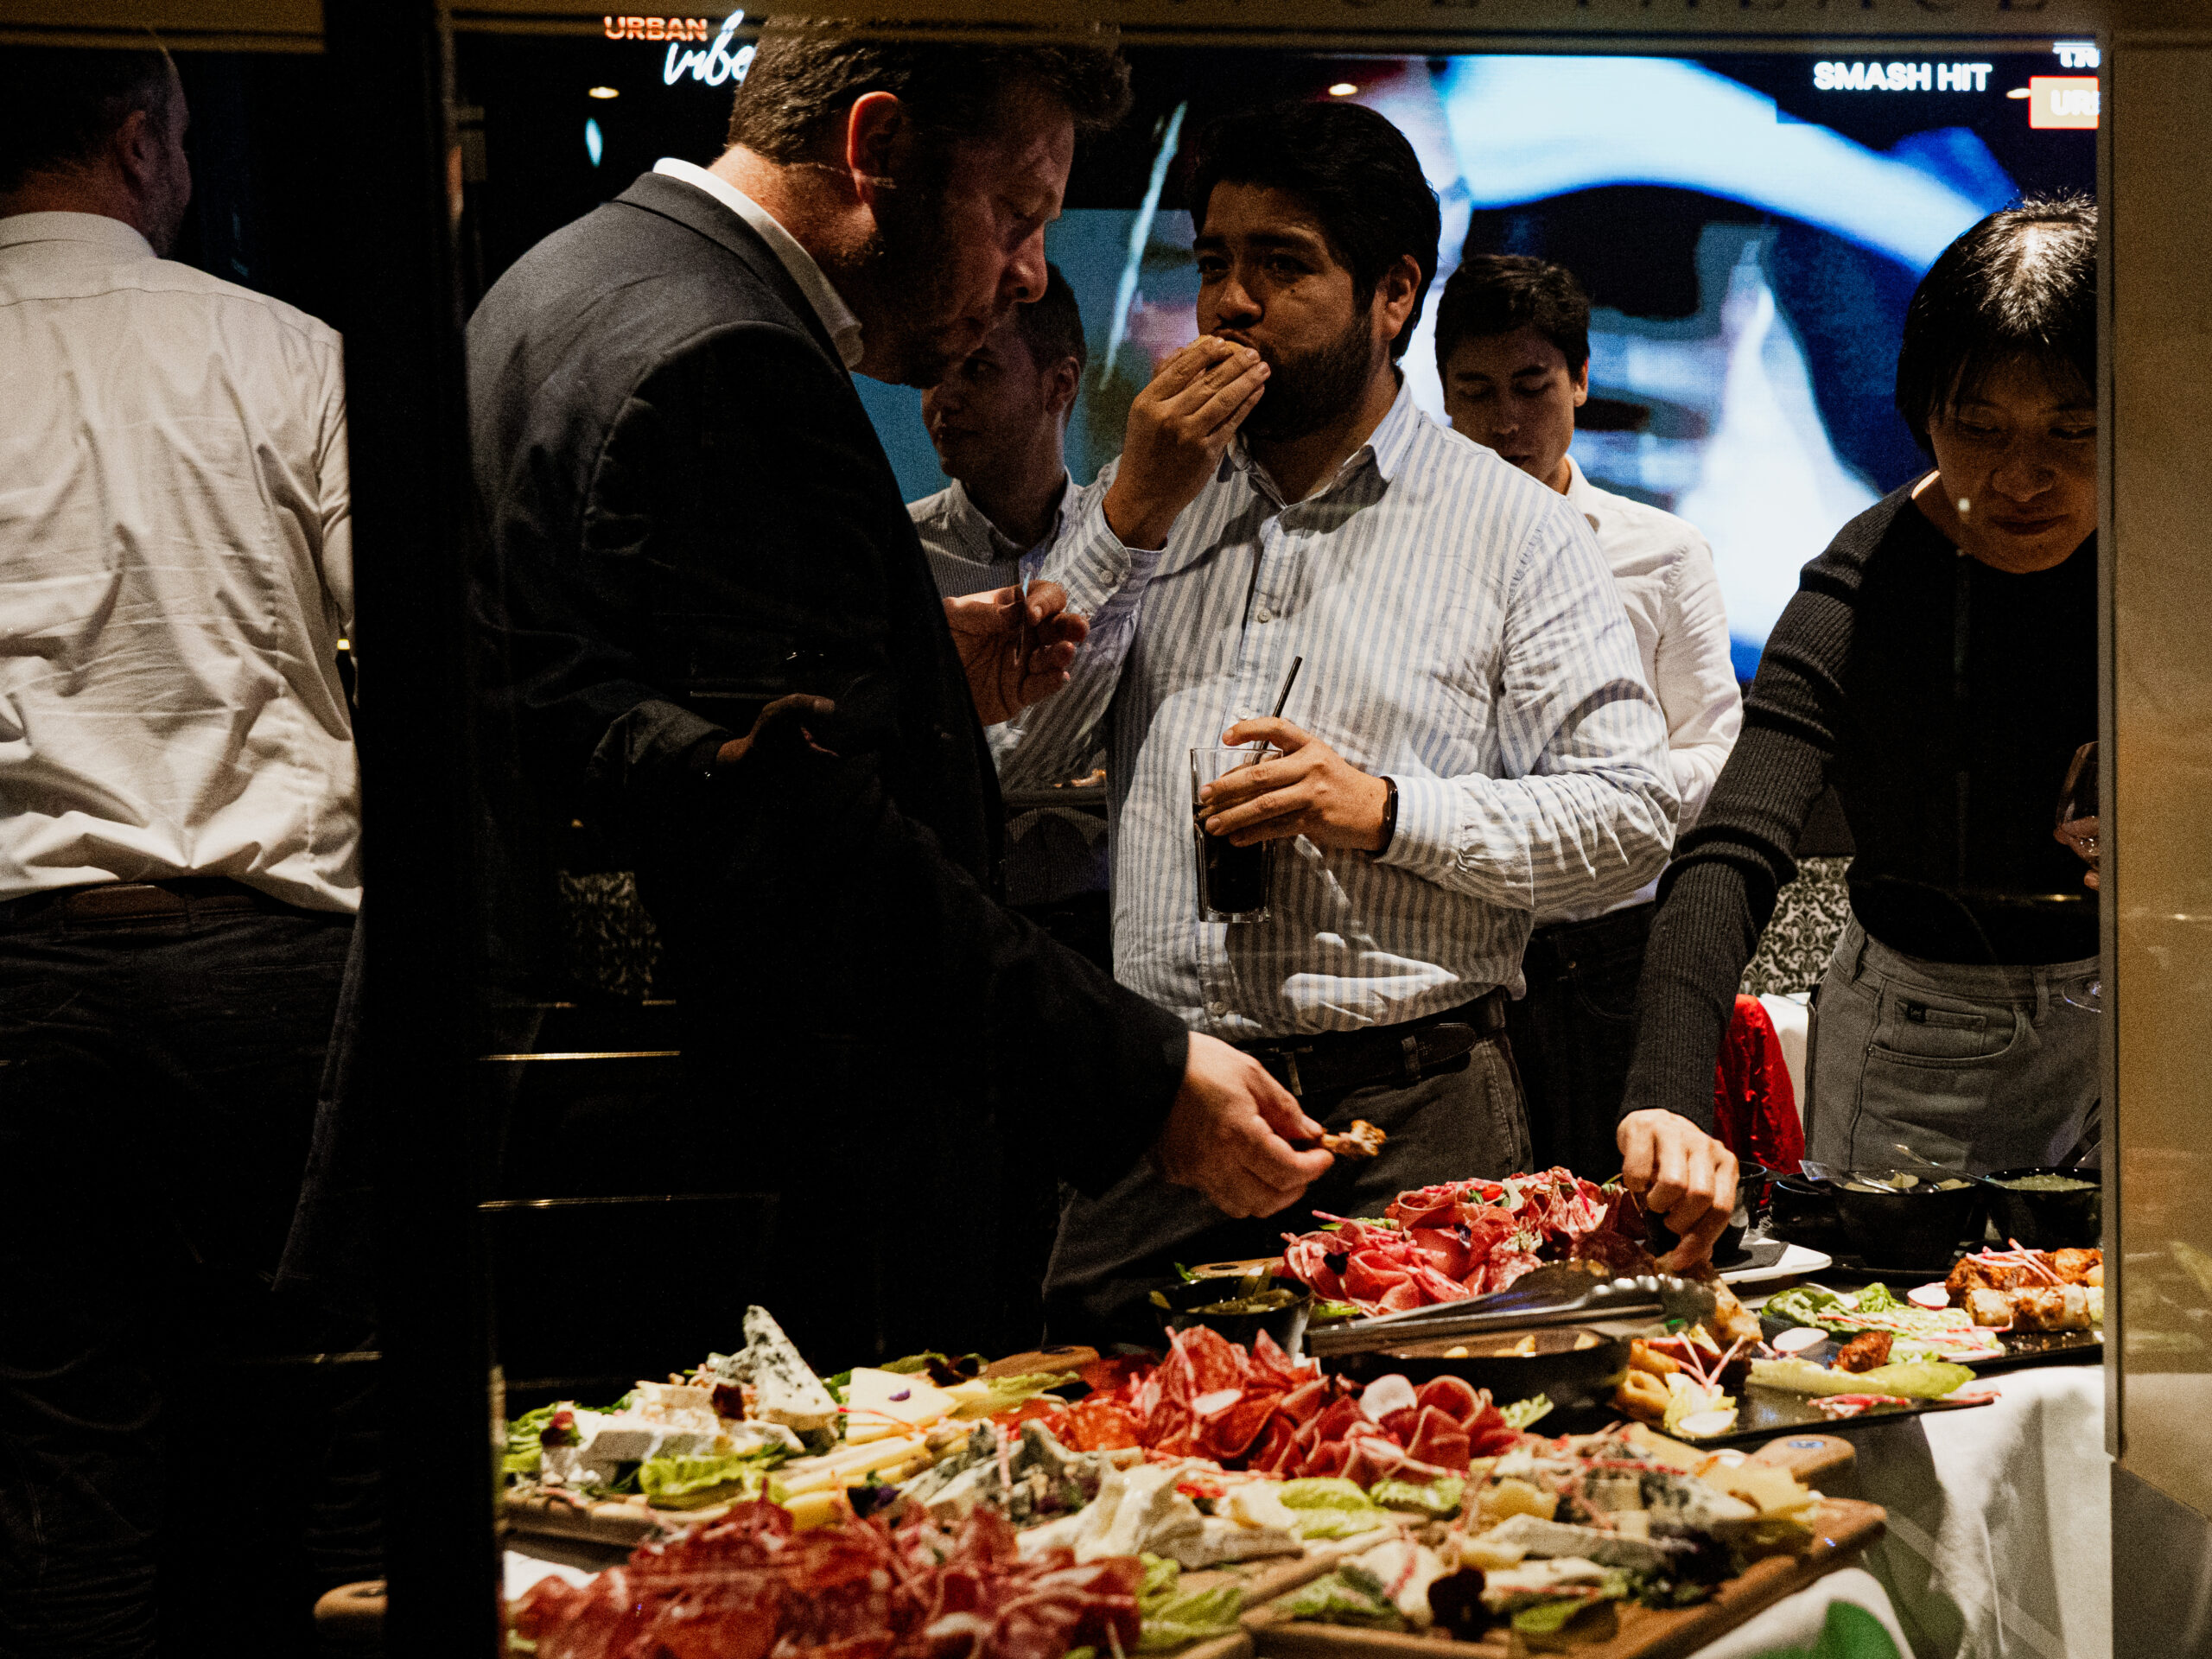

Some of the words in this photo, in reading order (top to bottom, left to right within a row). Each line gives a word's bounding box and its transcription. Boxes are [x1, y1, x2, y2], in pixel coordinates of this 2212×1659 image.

[604, 16, 709, 41] URBAN
[1814, 60, 1932, 91] SMASH
[1936, 62, 1993, 92] HIT
